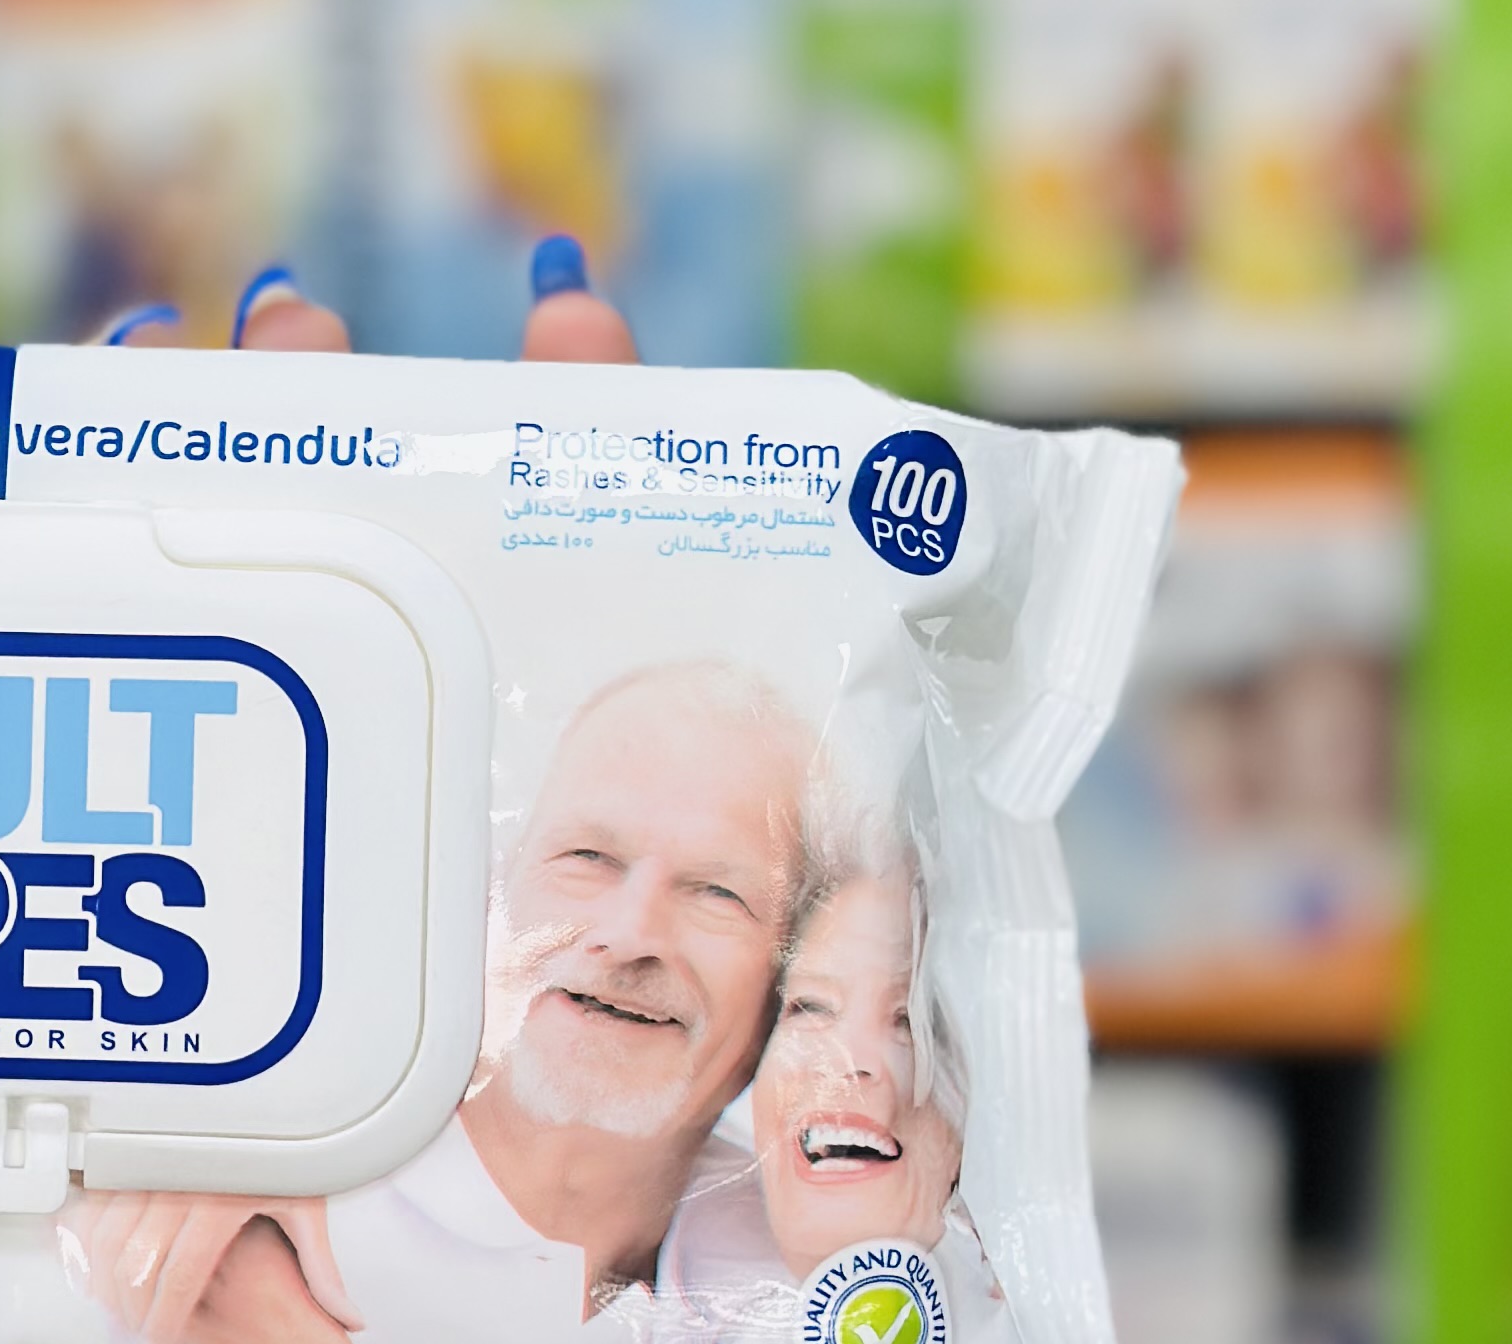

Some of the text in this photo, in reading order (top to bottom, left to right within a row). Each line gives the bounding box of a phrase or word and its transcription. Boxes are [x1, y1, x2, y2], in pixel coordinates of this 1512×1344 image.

[15, 419, 403, 467] vera/Calendula
[514, 423, 840, 469] Protection from
[509, 462, 626, 489] Rashes
[871, 457, 956, 526] 100
[872, 517, 945, 563] PCS
[100, 1030, 201, 1053] SKIN
[853, 1248, 901, 1274] AND
